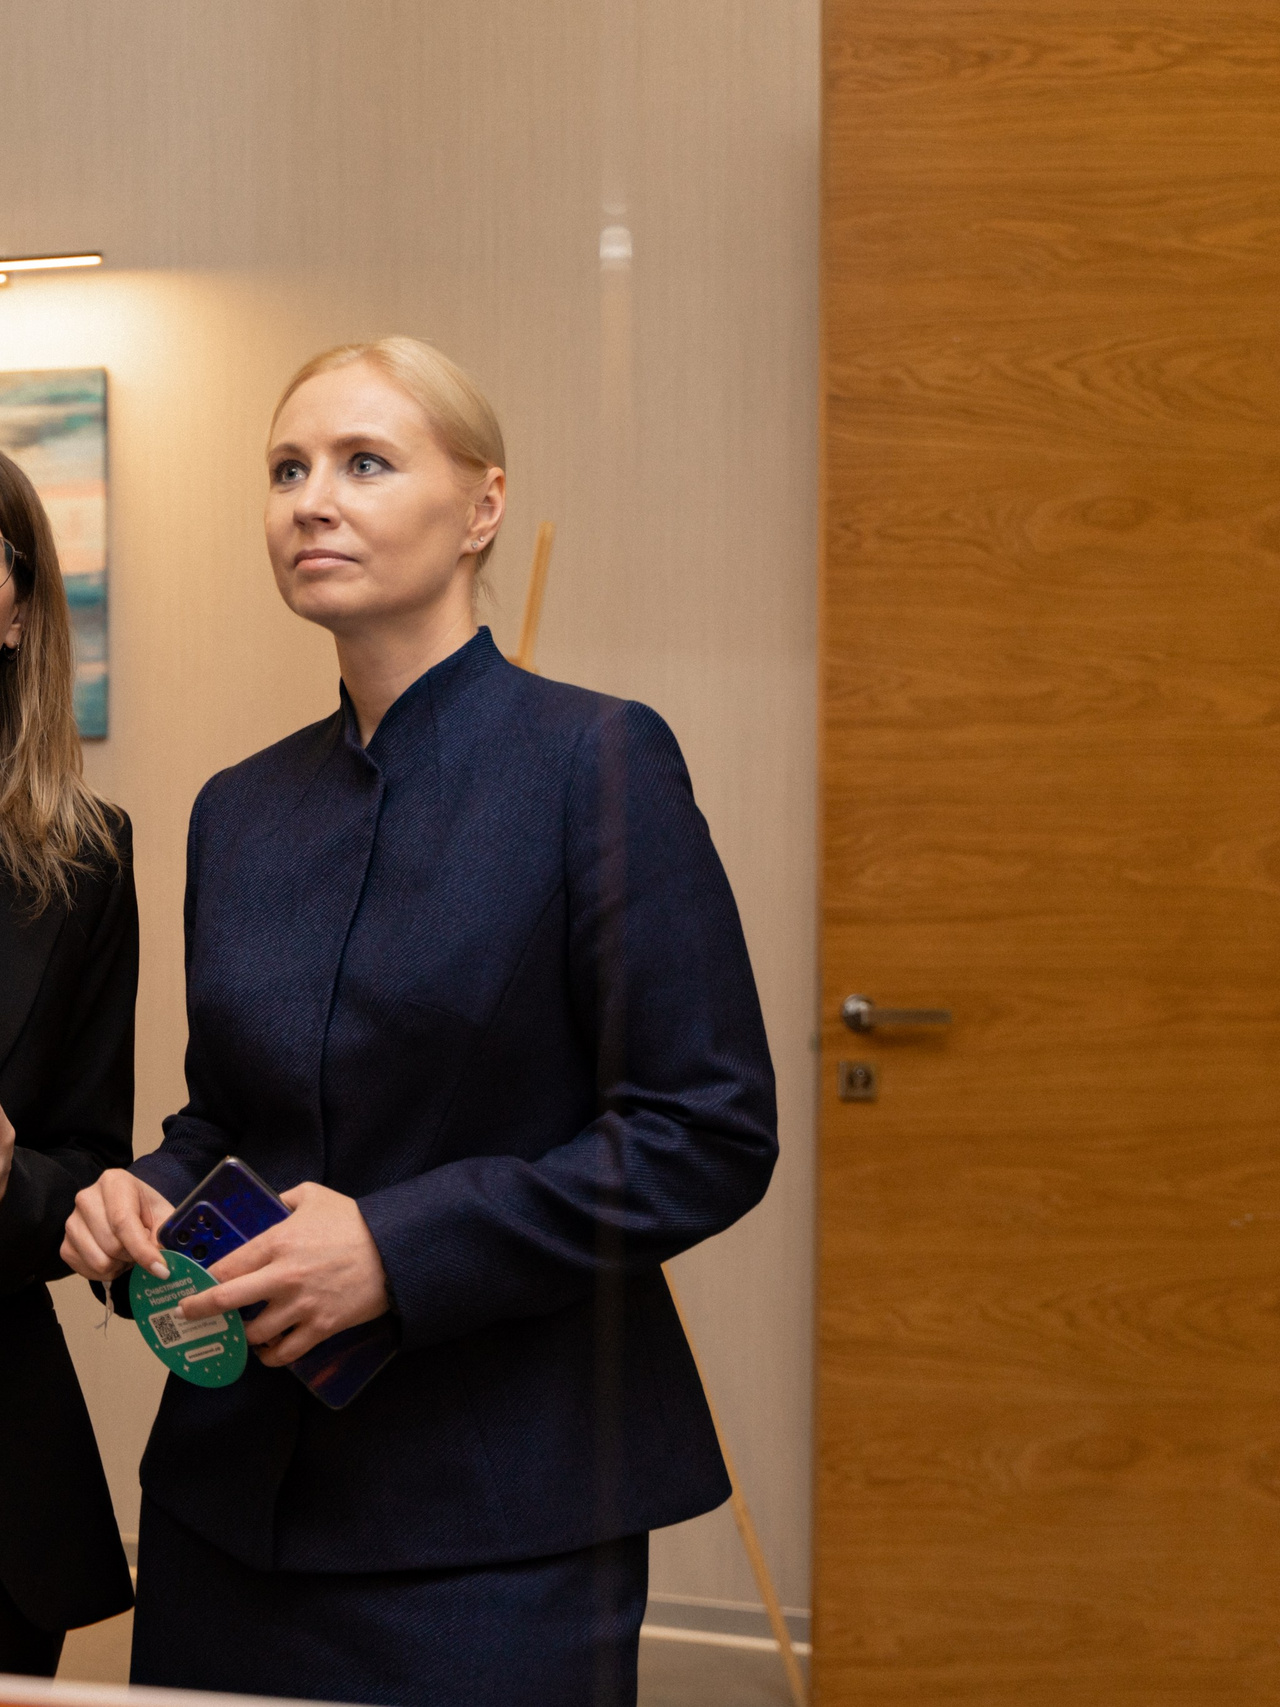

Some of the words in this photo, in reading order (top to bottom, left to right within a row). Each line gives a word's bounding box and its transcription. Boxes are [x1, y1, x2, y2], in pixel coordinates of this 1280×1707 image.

[144, 1276, 193, 1298] Счастливого
[148, 1293, 178, 1307] Нового
[176, 1284, 198, 1298] года!
